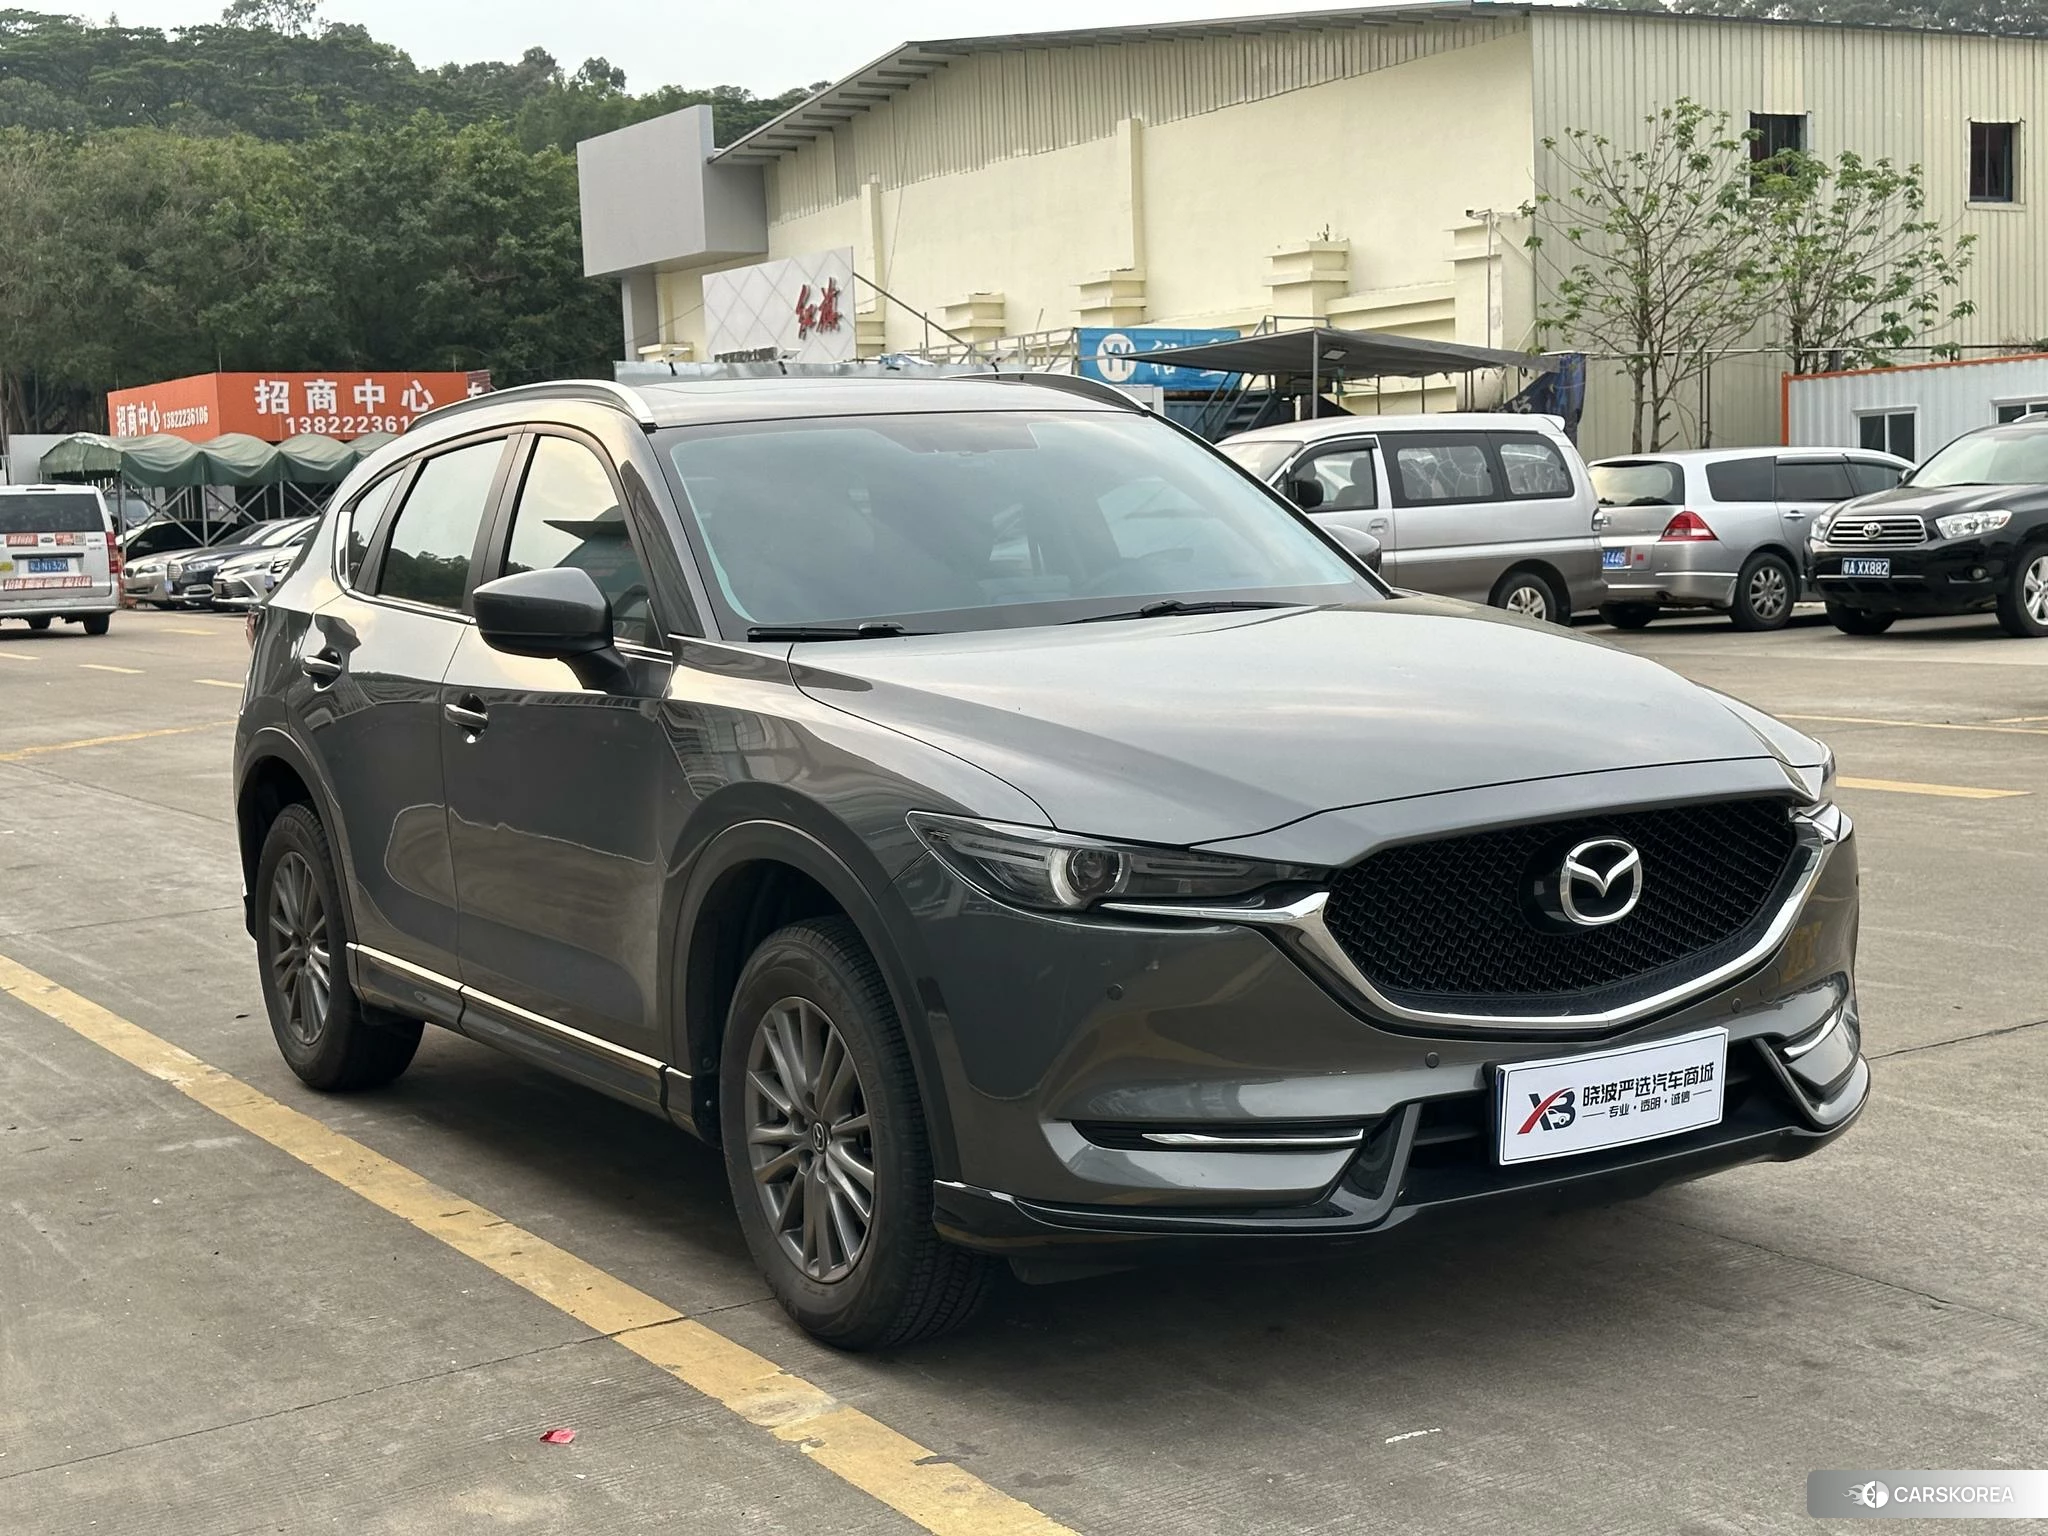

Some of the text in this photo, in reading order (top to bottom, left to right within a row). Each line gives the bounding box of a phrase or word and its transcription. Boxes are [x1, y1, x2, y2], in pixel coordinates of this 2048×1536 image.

[254, 378, 434, 415] 招商中心
[116, 400, 209, 437] 招商中心 13822236106
[286, 414, 409, 434] 138222361
[1582, 1061, 1715, 1107] 晓波严选汽车商城
